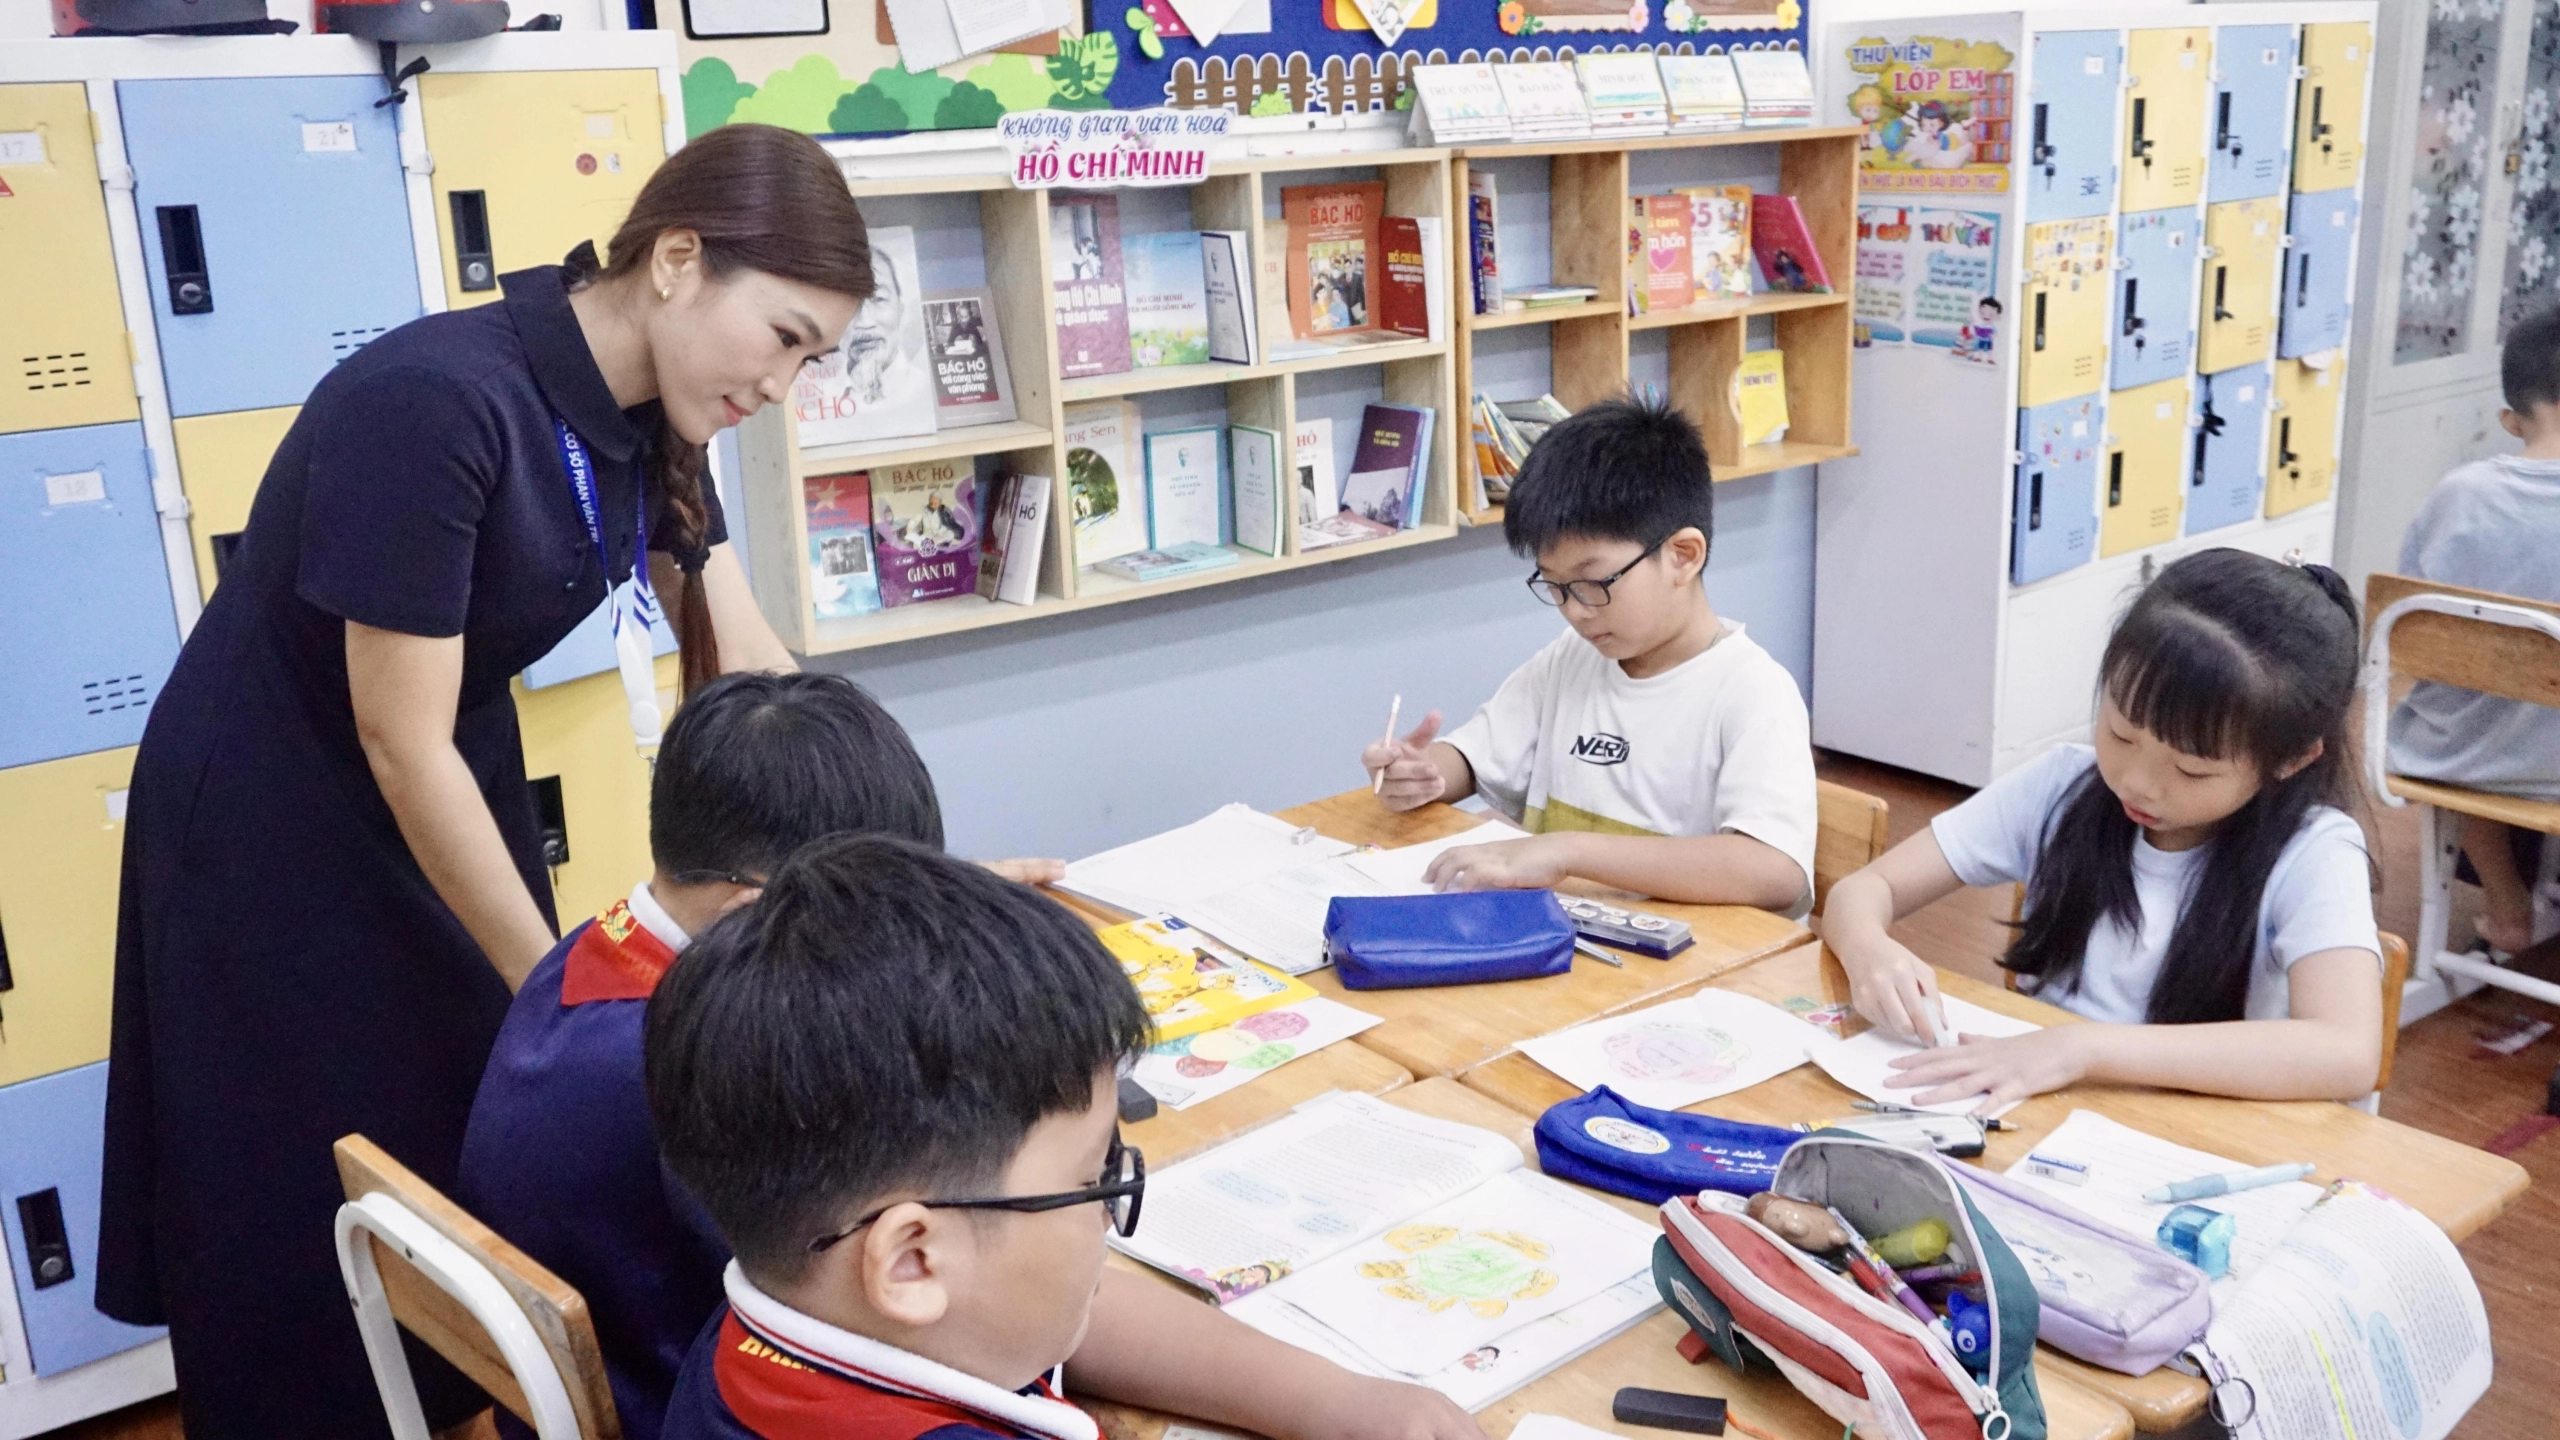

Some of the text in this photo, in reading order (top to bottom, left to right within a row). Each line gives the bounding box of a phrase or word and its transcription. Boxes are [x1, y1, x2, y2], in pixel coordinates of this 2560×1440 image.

[1895, 65, 1985, 92] LỚP EM
[1017, 140, 1206, 181] HỒ CHÍ MINH
[937, 356, 987, 376] BÁC HỒ
[1090, 426, 1117, 438] Sen
[573, 469, 590, 501] PHAN
[1018, 500, 1037, 521] HỒ
